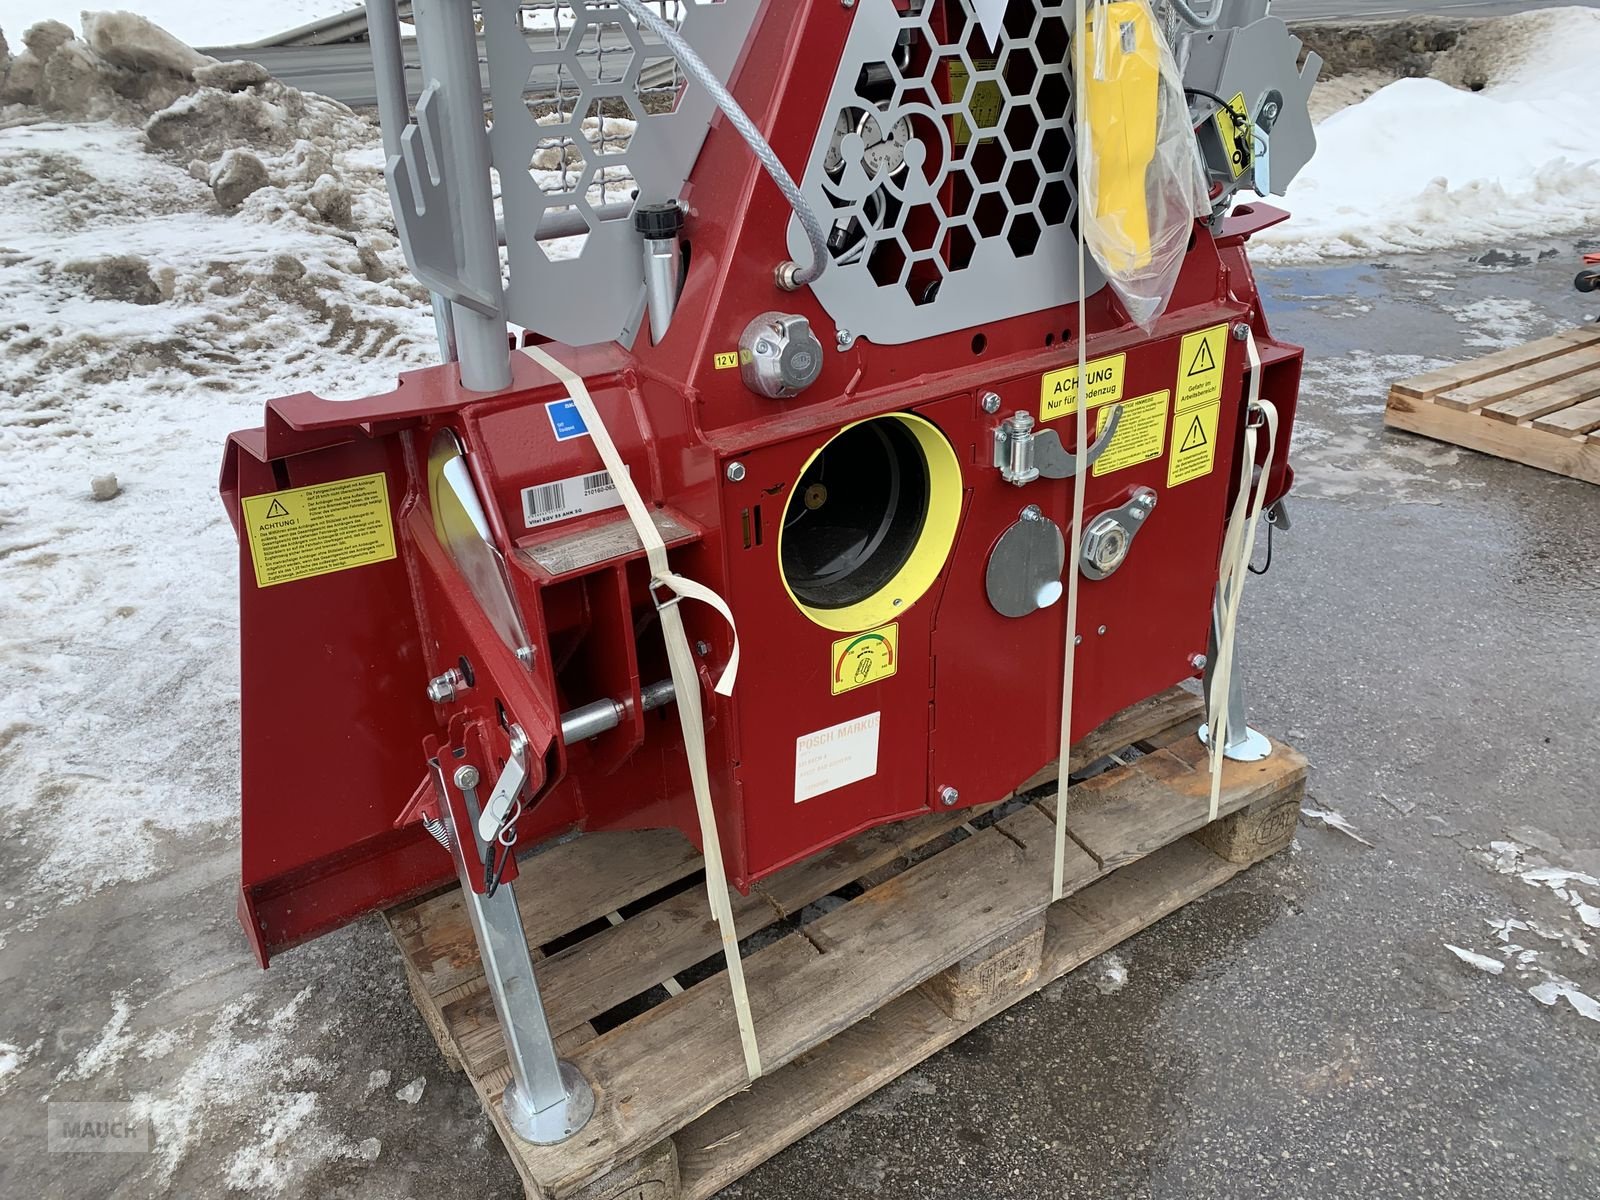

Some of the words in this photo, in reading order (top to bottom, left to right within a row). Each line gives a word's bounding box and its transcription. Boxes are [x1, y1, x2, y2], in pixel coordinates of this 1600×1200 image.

[718, 356, 726, 366] 12
[728, 354, 734, 364] V
[1054, 367, 1112, 395] ACHUNG
[1188, 383, 1204, 392] Gefahr
[1181, 386, 1217, 402] Arbeitsbereich!
[1048, 400, 1062, 410] Nur
[1064, 395, 1076, 406] für
[260, 519, 295, 530] ACHTUNG
[799, 732, 834, 752] POSCH
[838, 716, 880, 738] MARKUS
